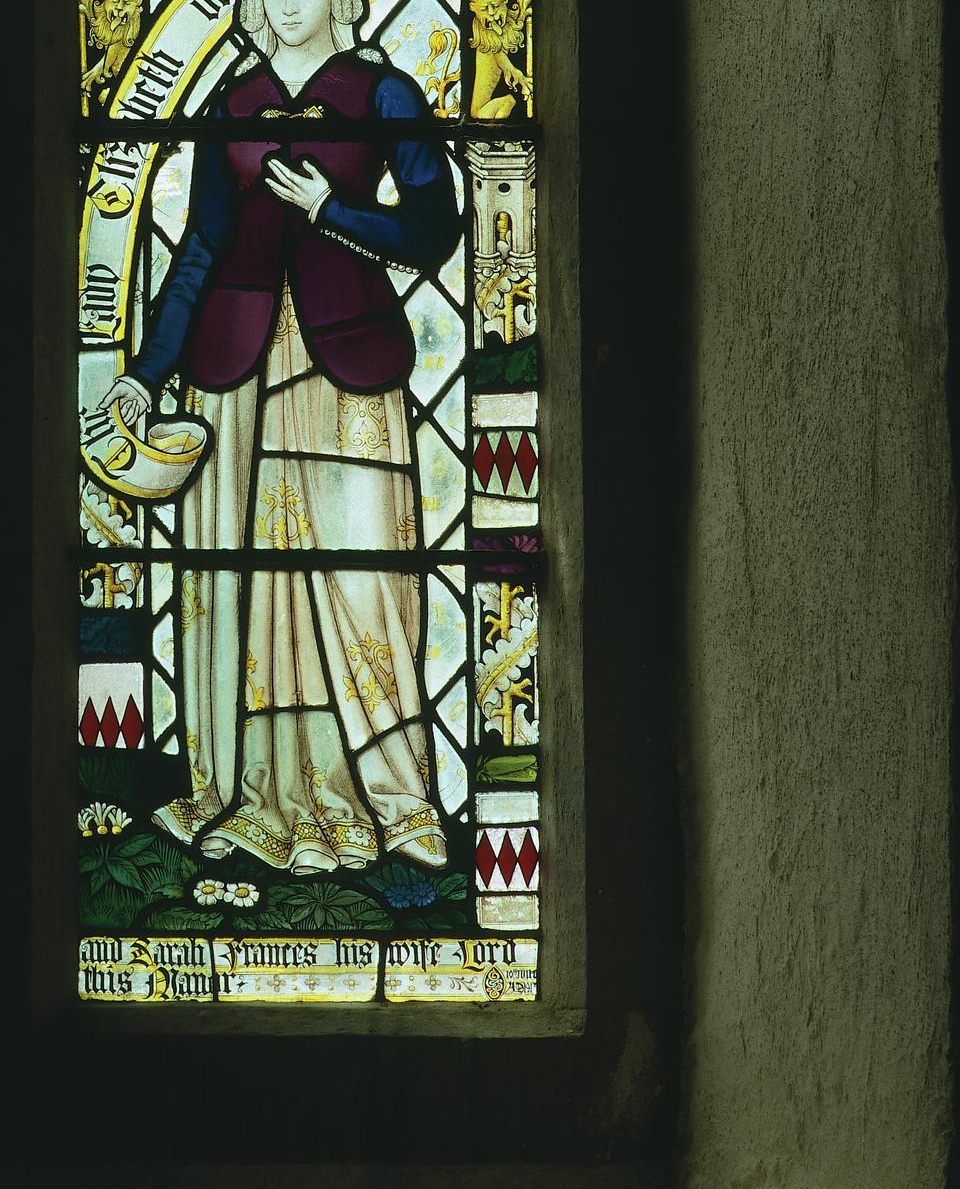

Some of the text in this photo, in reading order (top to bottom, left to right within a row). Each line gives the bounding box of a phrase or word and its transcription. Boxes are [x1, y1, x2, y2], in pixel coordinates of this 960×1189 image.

[81, 938, 123, 964] and
[334, 938, 376, 969] his
[82, 964, 135, 997] this
